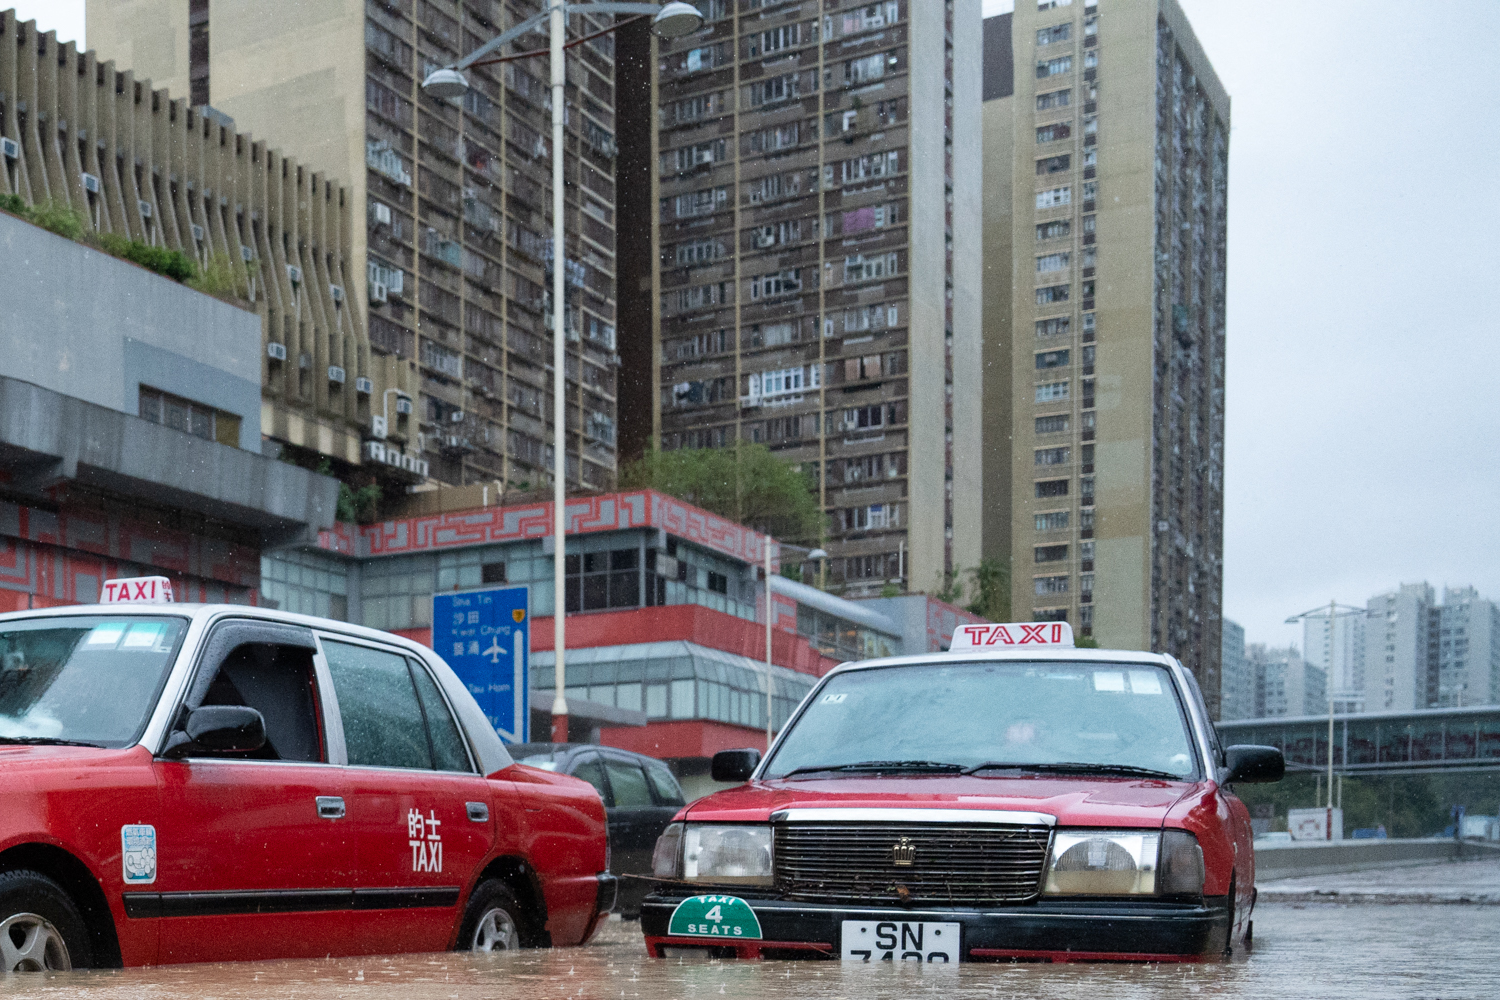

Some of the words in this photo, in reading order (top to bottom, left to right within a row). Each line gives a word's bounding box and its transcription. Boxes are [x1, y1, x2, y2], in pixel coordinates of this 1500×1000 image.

[105, 580, 156, 602] TAXI
[453, 610, 480, 625] 沙田
[964, 623, 1062, 646] TAXI
[407, 808, 442, 840] 的士
[408, 840, 443, 873] TAXI
[698, 896, 736, 905] TAXI
[705, 905, 723, 923] 4
[687, 923, 743, 936] SEATS
[875, 922, 924, 951] SN
